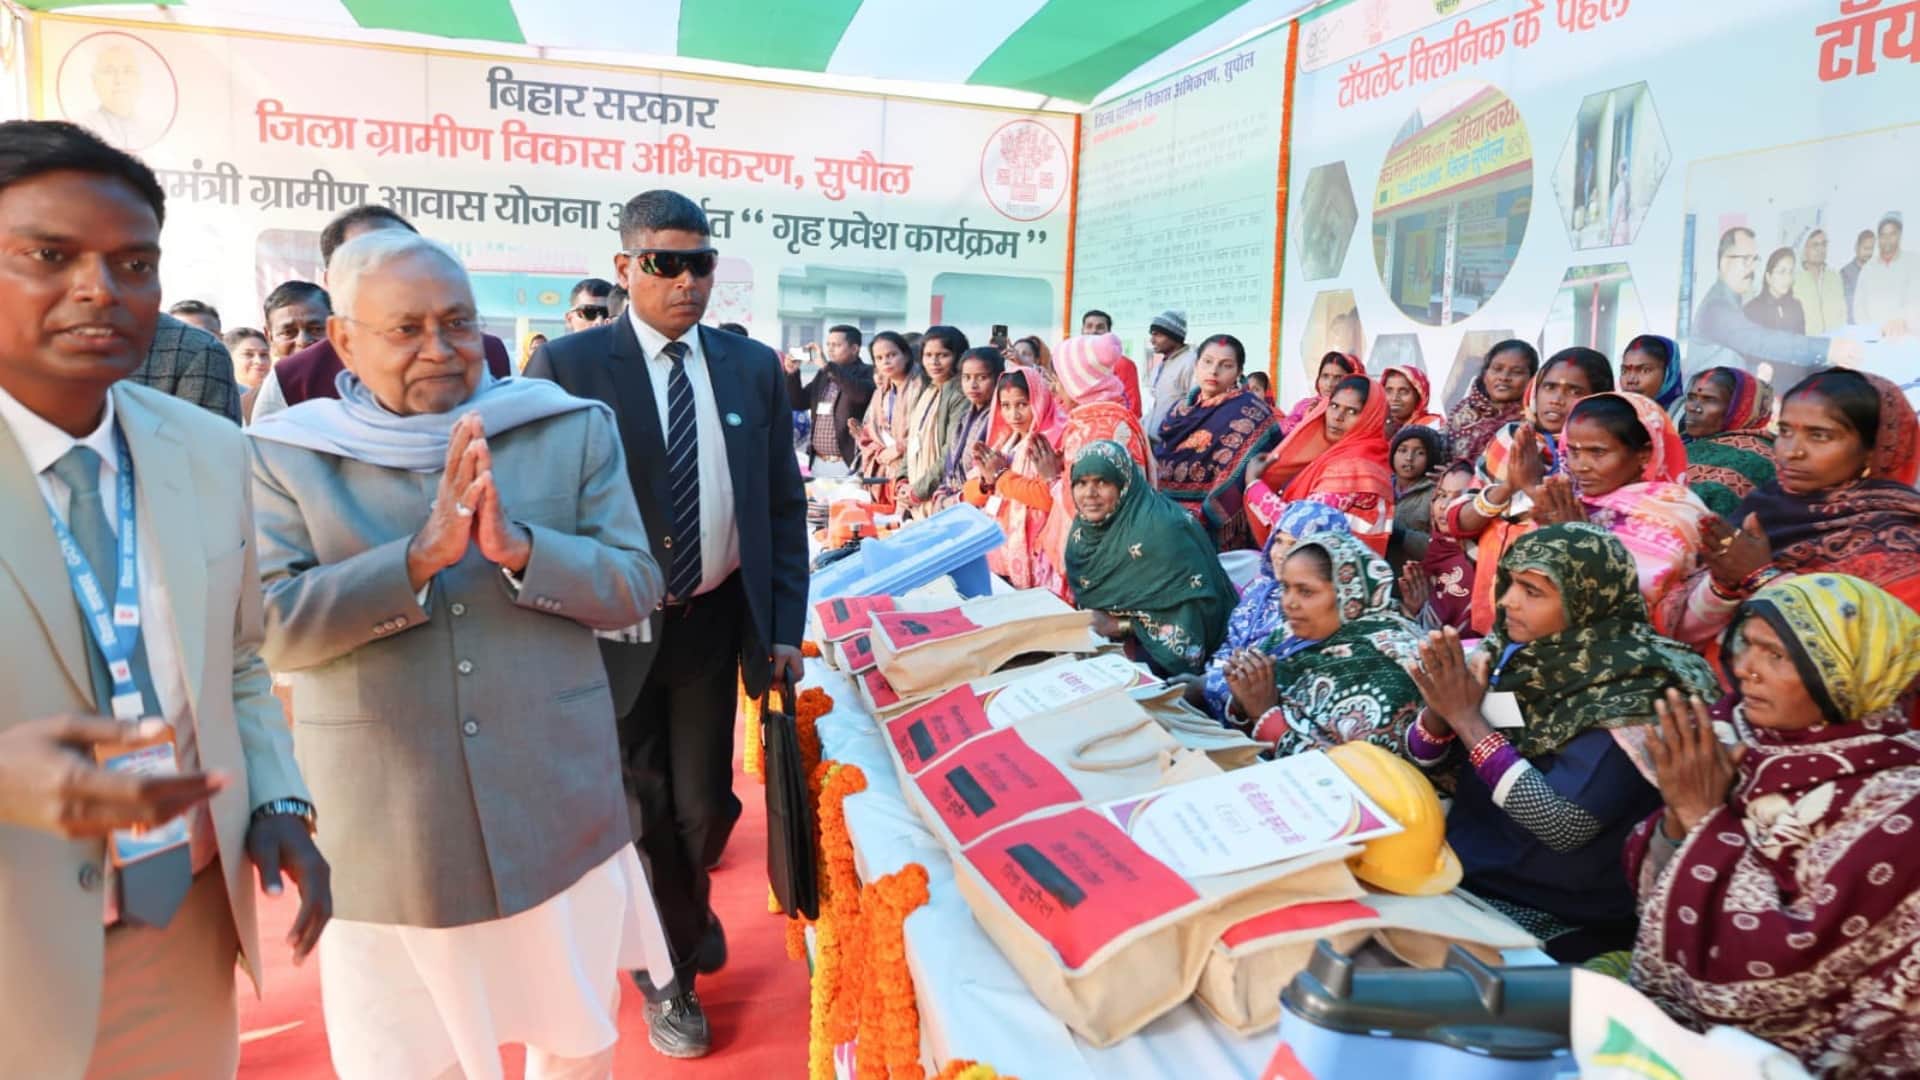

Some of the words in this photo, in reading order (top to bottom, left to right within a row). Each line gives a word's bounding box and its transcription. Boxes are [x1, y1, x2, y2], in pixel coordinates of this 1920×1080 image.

[486, 66, 588, 117] बिहार
[593, 87, 719, 129] सरकार
[1338, 52, 1407, 107] टॉयलेट
[1409, 16, 1509, 86] क्लिनिक
[256, 98, 358, 150] जिला
[364, 113, 494, 160] ग्रामीण
[501, 119, 625, 171] विकास
[633, 134, 805, 190] अभिकरण,
[815, 149, 914, 200] सुपौल
[248, 169, 369, 212] ग्रामीण
[378, 186, 488, 222] आवास
[494, 185, 601, 229] योजना
[772, 213, 824, 254] गृह
[828, 211, 899, 250] प्रवेश
[905, 217, 1020, 260] कार्यक्रम
